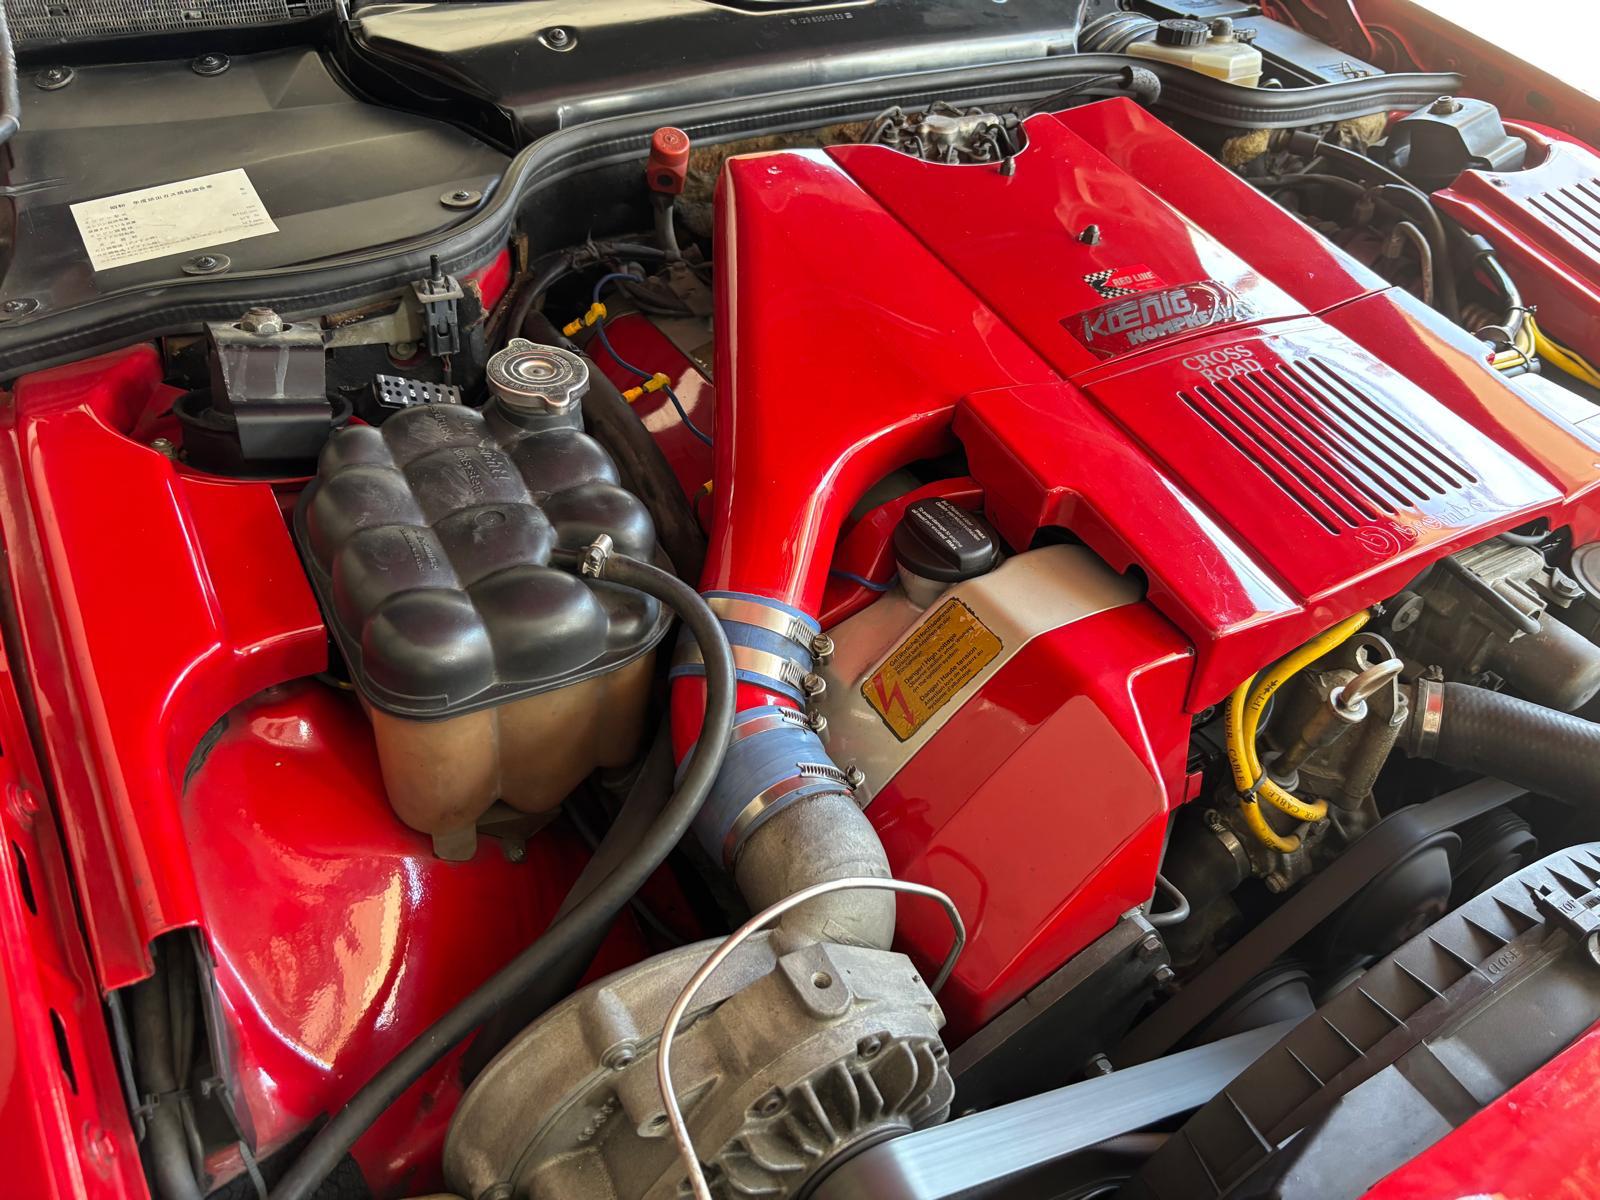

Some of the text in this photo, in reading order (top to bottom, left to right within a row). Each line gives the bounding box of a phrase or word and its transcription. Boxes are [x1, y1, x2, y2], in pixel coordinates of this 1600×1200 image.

[1112, 274, 1134, 287] RED
[1134, 271, 1156, 282] LINE
[1181, 345, 1253, 371] CROSS
[1200, 359, 1260, 381] ROAD
[380, 374, 405, 385] 1 3
[383, 389, 456, 404] 2 4 5 6 7 8
[931, 518, 946, 533] damage
[931, 525, 947, 540] exceed
[945, 539, 957, 551] max
[903, 632, 958, 684] Danger! High voltage
[919, 645, 977, 701] Danger! Haute tension
[1228, 748, 1245, 787] CABLE
[1266, 790, 1300, 814] CABLE
[1558, 899, 1577, 914] TOP
[1487, 948, 1521, 975] CLOSE
